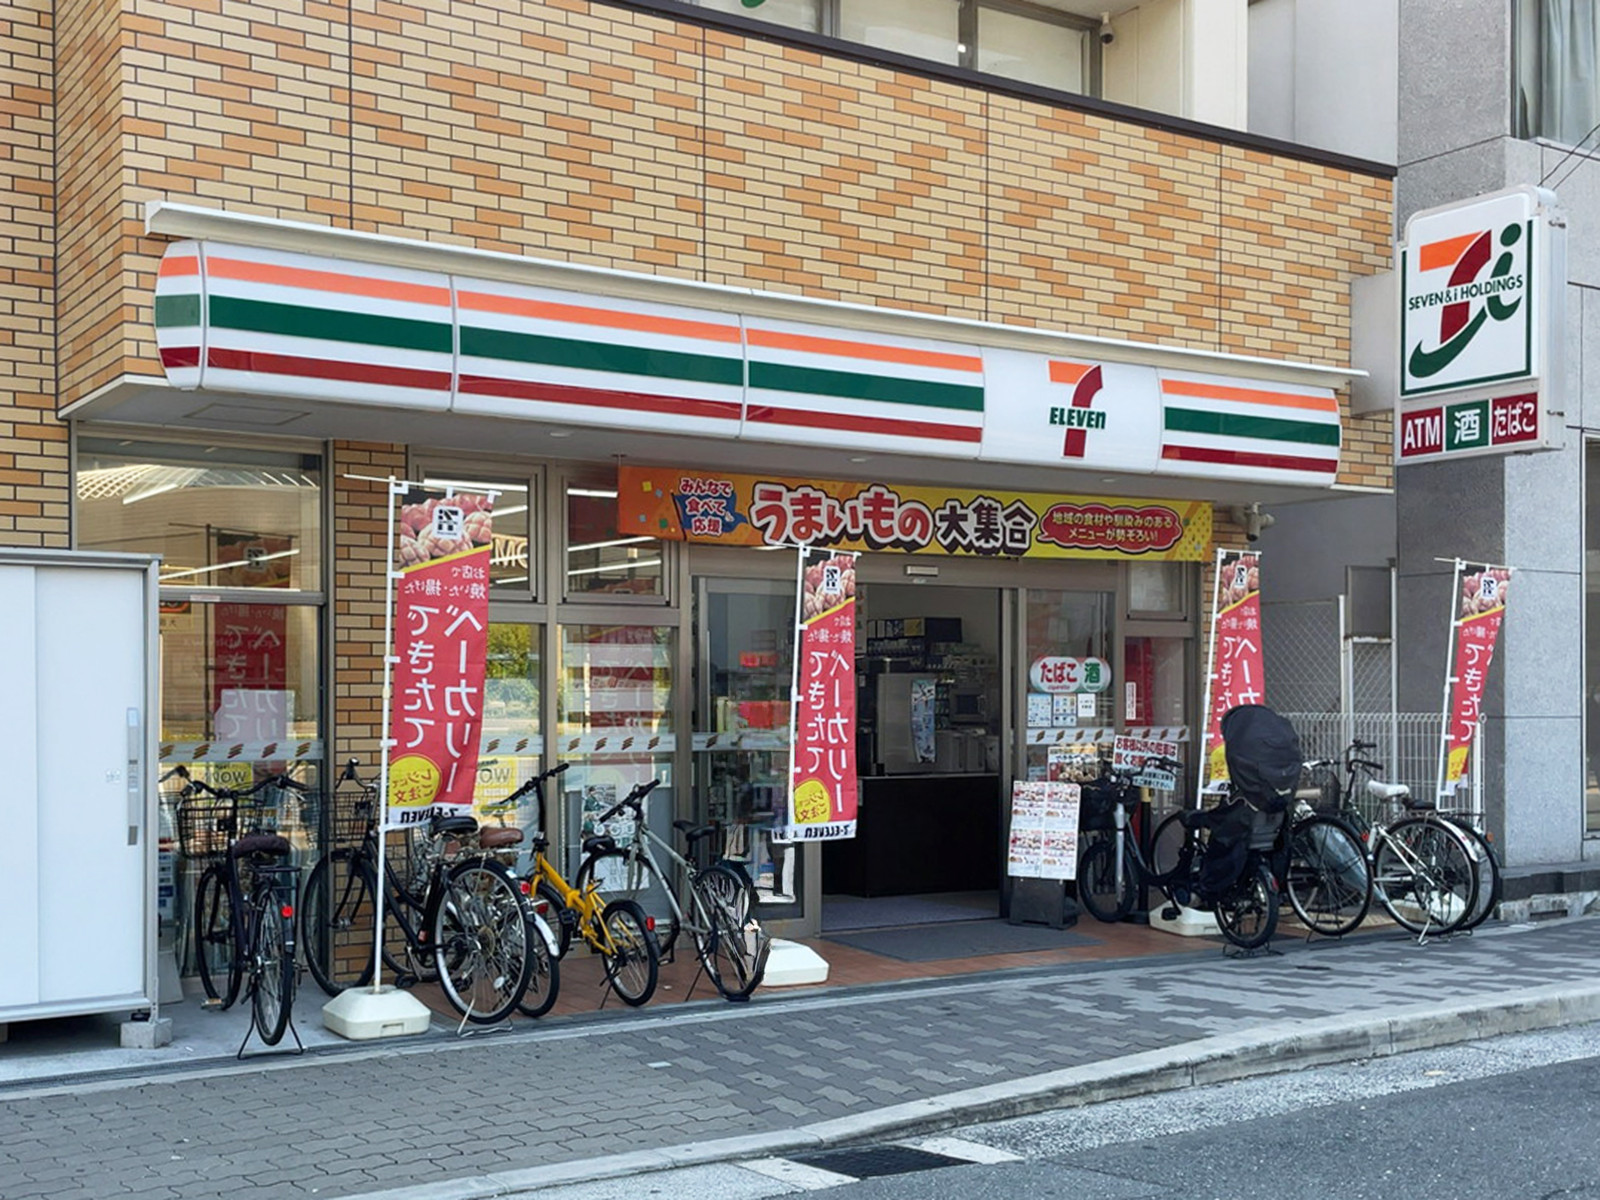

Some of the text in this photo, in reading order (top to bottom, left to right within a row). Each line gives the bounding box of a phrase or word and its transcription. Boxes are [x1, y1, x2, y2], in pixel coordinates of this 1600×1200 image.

[1460, 274, 1523, 299] HOLDINGS
[1454, 408, 1481, 443] 酒
[1493, 402, 1536, 437] たばこ
[1404, 415, 1441, 450] ATM
[679, 478, 733, 498] みんなで
[685, 498, 726, 515] 食べて
[691, 518, 723, 536] 応援
[1040, 662, 1078, 683] たばこ
[1084, 661, 1101, 683] 酒
